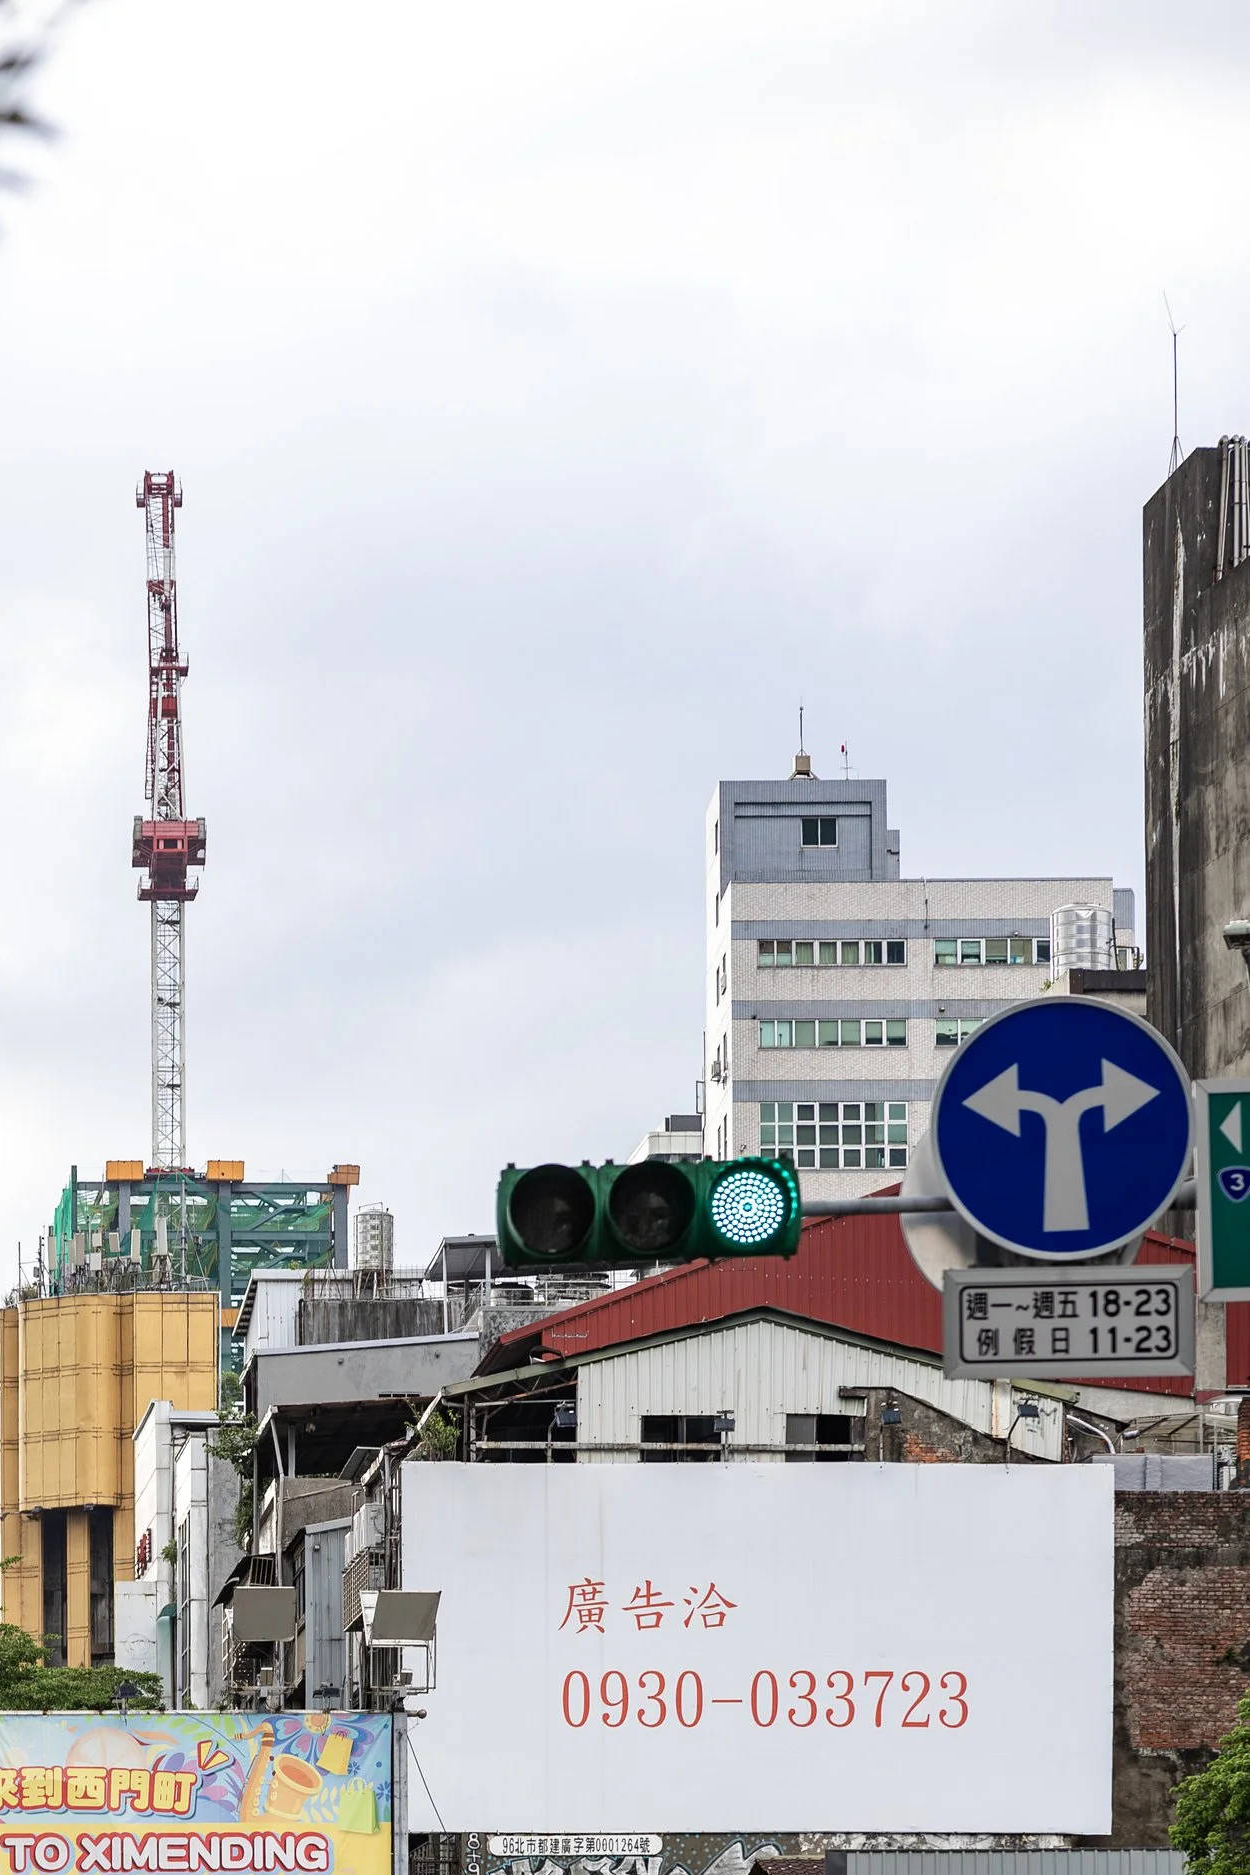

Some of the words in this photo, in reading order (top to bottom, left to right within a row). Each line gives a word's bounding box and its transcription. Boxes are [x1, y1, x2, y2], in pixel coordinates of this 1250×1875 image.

[1229, 1172, 1246, 1191] 3
[1089, 1288, 1173, 1319] 18-23
[976, 1327, 1071, 1357] 例假日
[1089, 1324, 1173, 1355] 11-23
[558, 1577, 739, 1635] 廣告洽
[561, 1669, 970, 1729] 0930-033723
[5, 1834, 70, 1873] TO
[81, 1833, 328, 1873] XIMENDING
